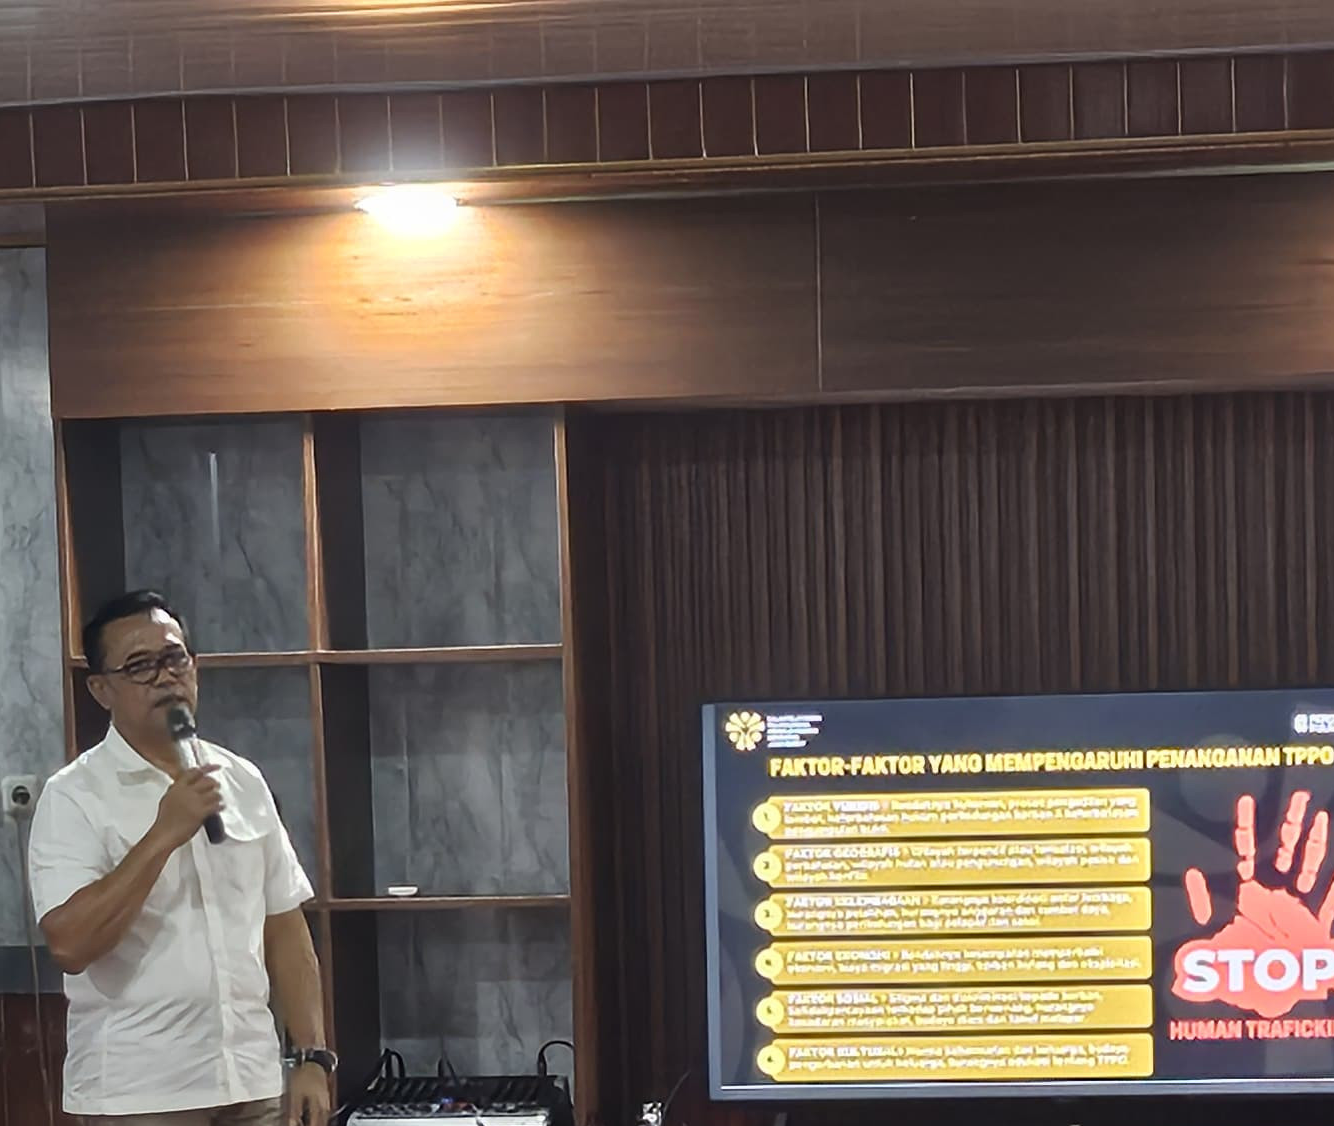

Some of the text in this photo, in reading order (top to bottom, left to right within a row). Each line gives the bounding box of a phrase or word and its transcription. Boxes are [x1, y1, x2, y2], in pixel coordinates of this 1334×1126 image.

[769, 746, 1334, 777] FAKTOR-FAKTOR YANG MEMPENGARUHI PENANGANAN TPPO
[1170, 1020, 1243, 1040] HUMAN
